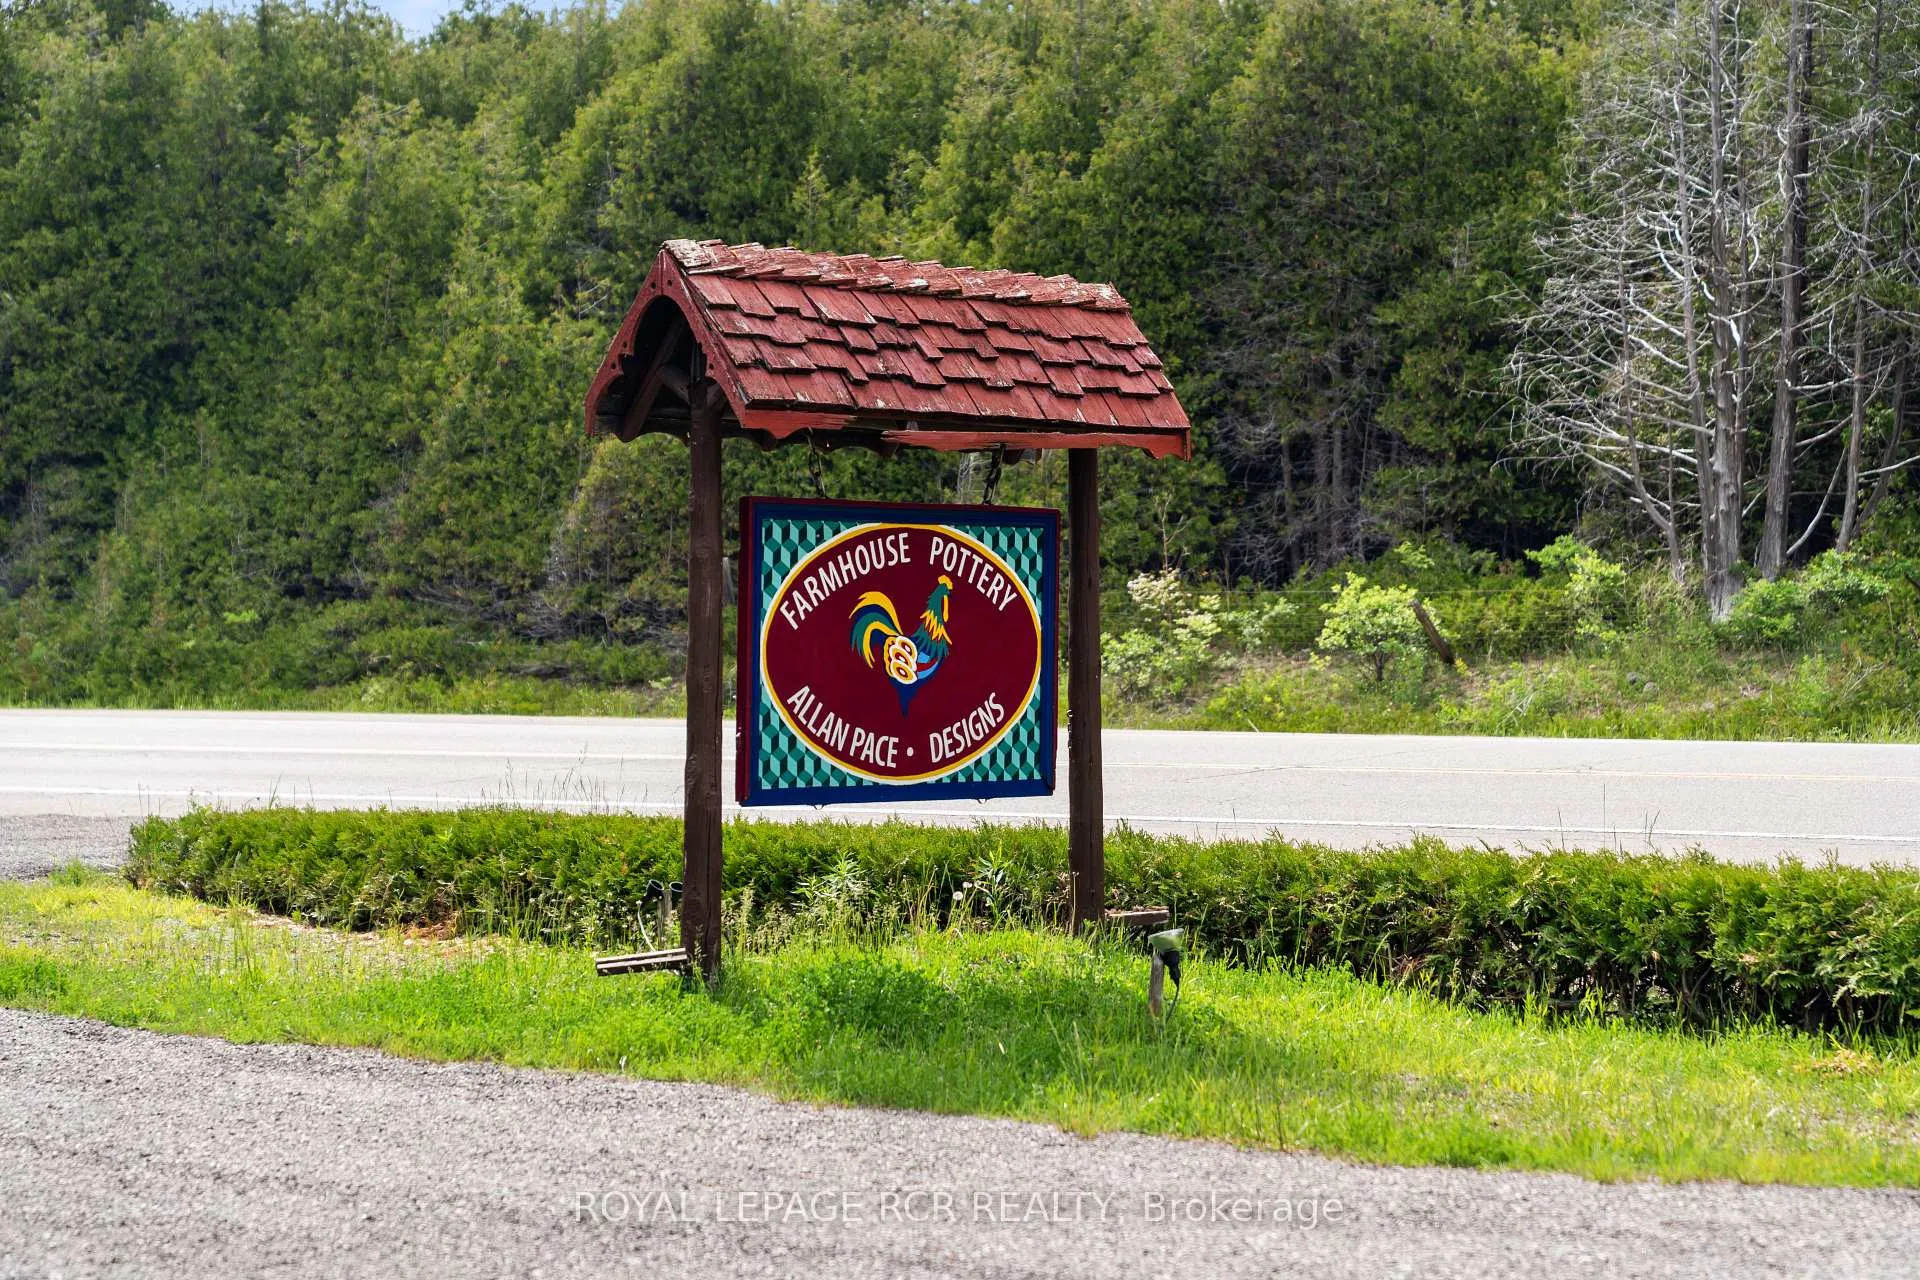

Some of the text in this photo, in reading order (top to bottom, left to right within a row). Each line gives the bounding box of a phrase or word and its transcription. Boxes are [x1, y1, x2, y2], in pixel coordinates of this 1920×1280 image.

[780, 533, 1018, 630] FARMHOUSE POTTERY
[787, 685, 1005, 768] ALLAN PACE DESIGNS
